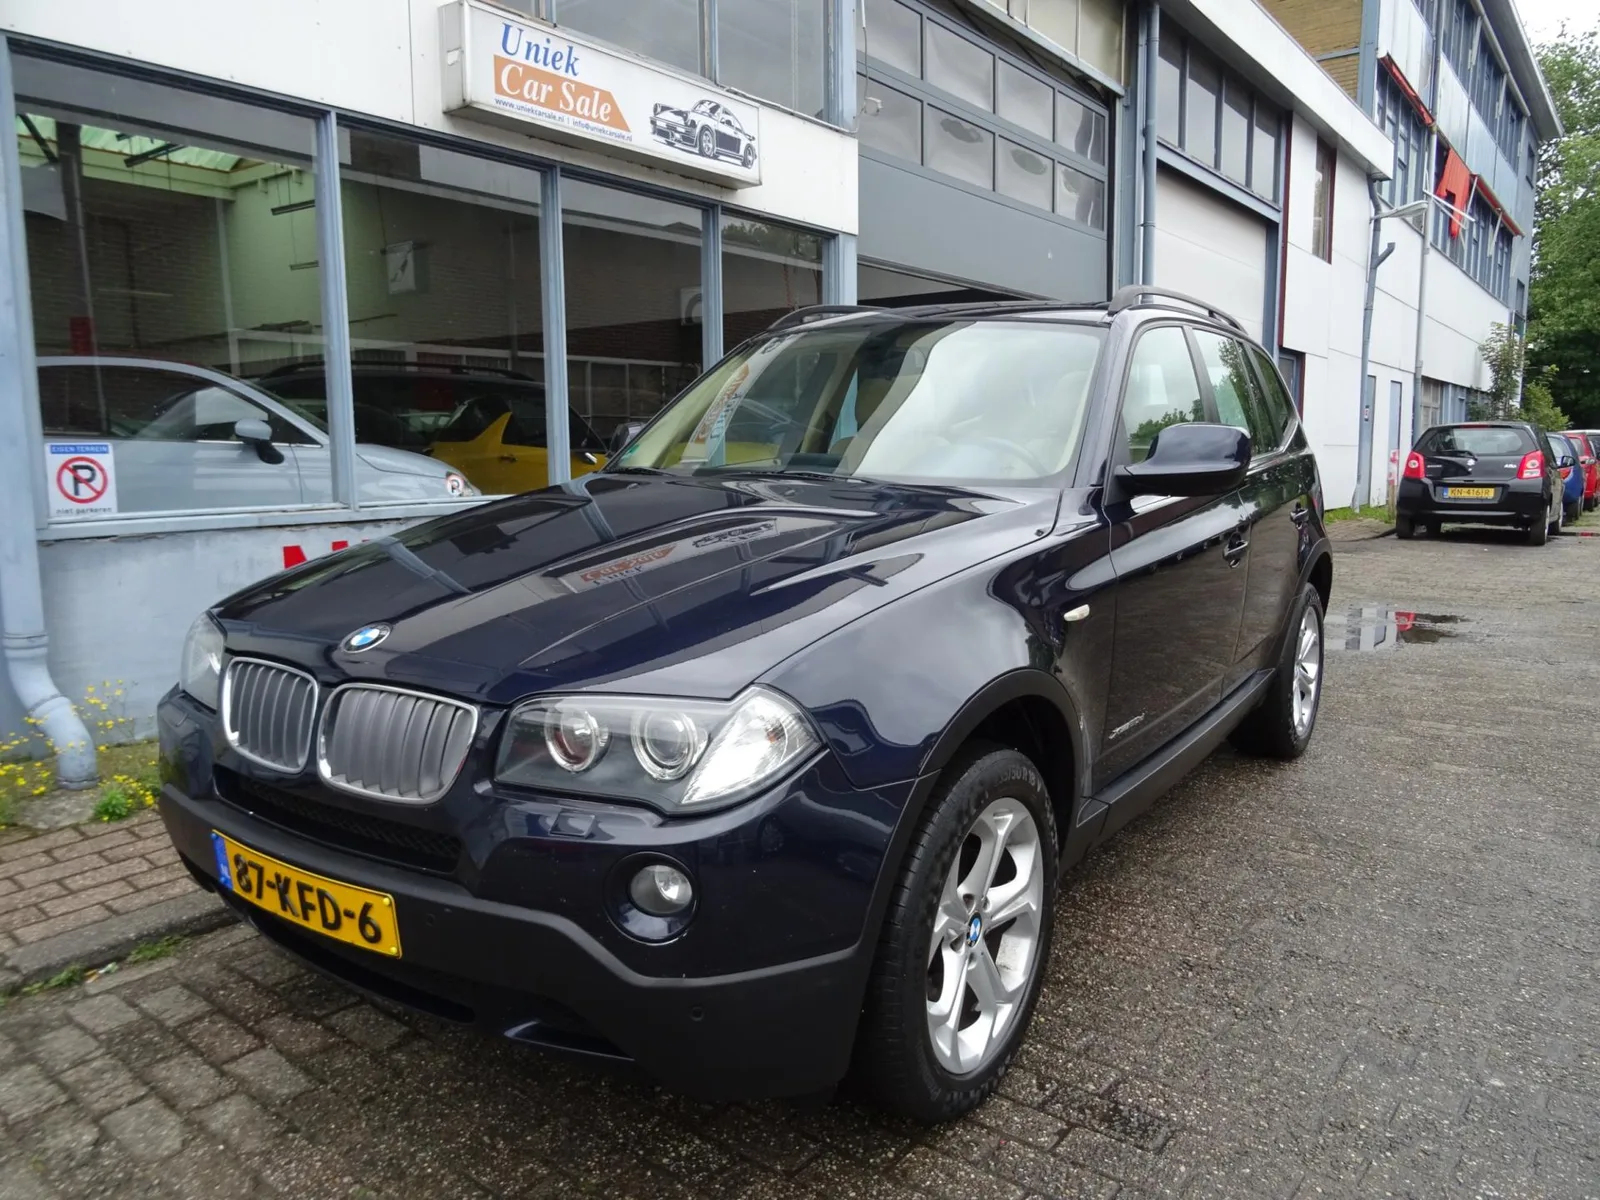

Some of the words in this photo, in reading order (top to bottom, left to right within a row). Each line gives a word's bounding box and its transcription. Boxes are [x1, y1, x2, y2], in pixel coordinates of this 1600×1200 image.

[502, 23, 579, 76] Uniek
[494, 98, 565, 123] www.uniekcarsale.nl
[573, 120, 633, 142] info@uniekcarsale.nl
[501, 64, 553, 103] Car
[560, 82, 611, 122] Sale
[234, 853, 382, 944] 87-KFD-6
